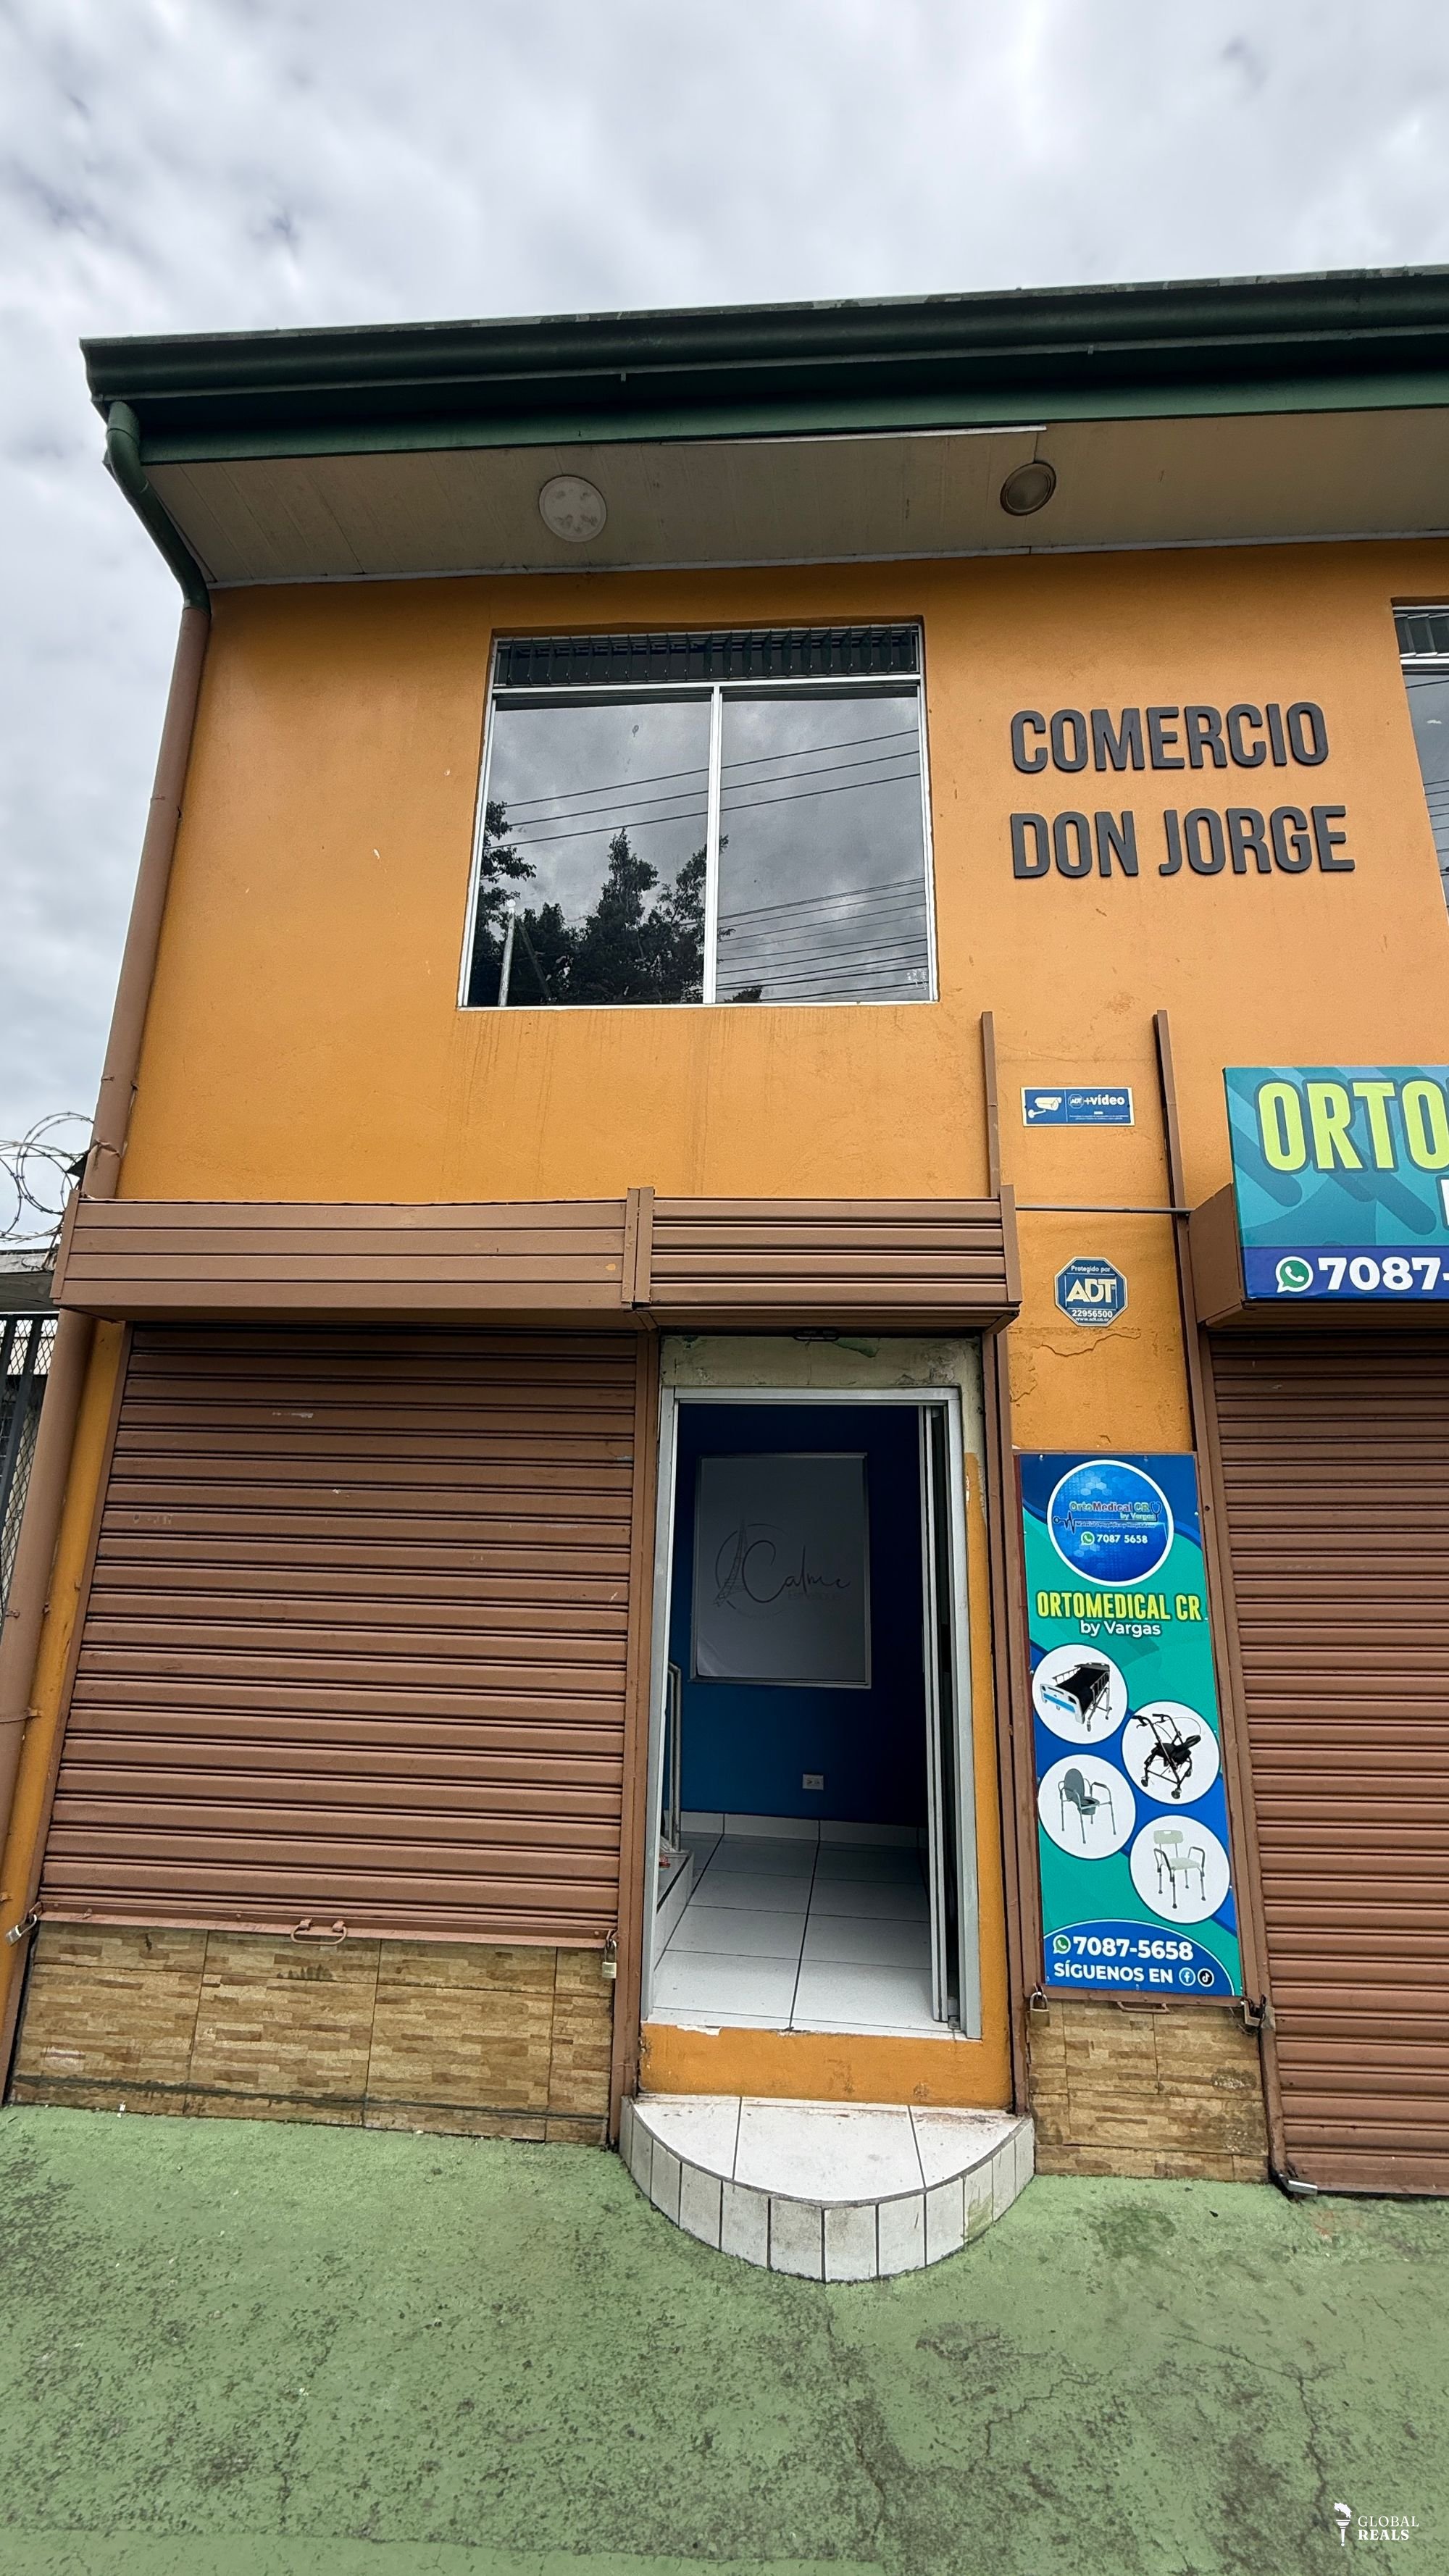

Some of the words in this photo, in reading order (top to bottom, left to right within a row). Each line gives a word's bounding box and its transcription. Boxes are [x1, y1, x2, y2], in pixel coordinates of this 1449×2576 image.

[1010, 701, 1329, 773] COMERCIO
[1010, 811, 1140, 879] DON
[1158, 805, 1356, 875] JORGE
[1258, 1079, 1449, 1171] ORTO
[1066, 1278, 1116, 1303] ADT
[1072, 1309, 1113, 1318] 22956500
[1069, 1501, 1132, 1512] OrtoMedical
[1134, 1502, 1150, 1513] CR
[1096, 1534, 1121, 1544] 7087
[1124, 1534, 1148, 1544] 5658
[1037, 1592, 1171, 1621] ORTOMEDICAL
[1175, 1594, 1202, 1621] CR
[1080, 1619, 1100, 1636] by
[1103, 1621, 1161, 1638] Vargas
[1073, 1936, 1194, 1961] 7087-5658
[1053, 1960, 1145, 1983] SÍGUENOS
[1148, 1968, 1174, 1984] EN
